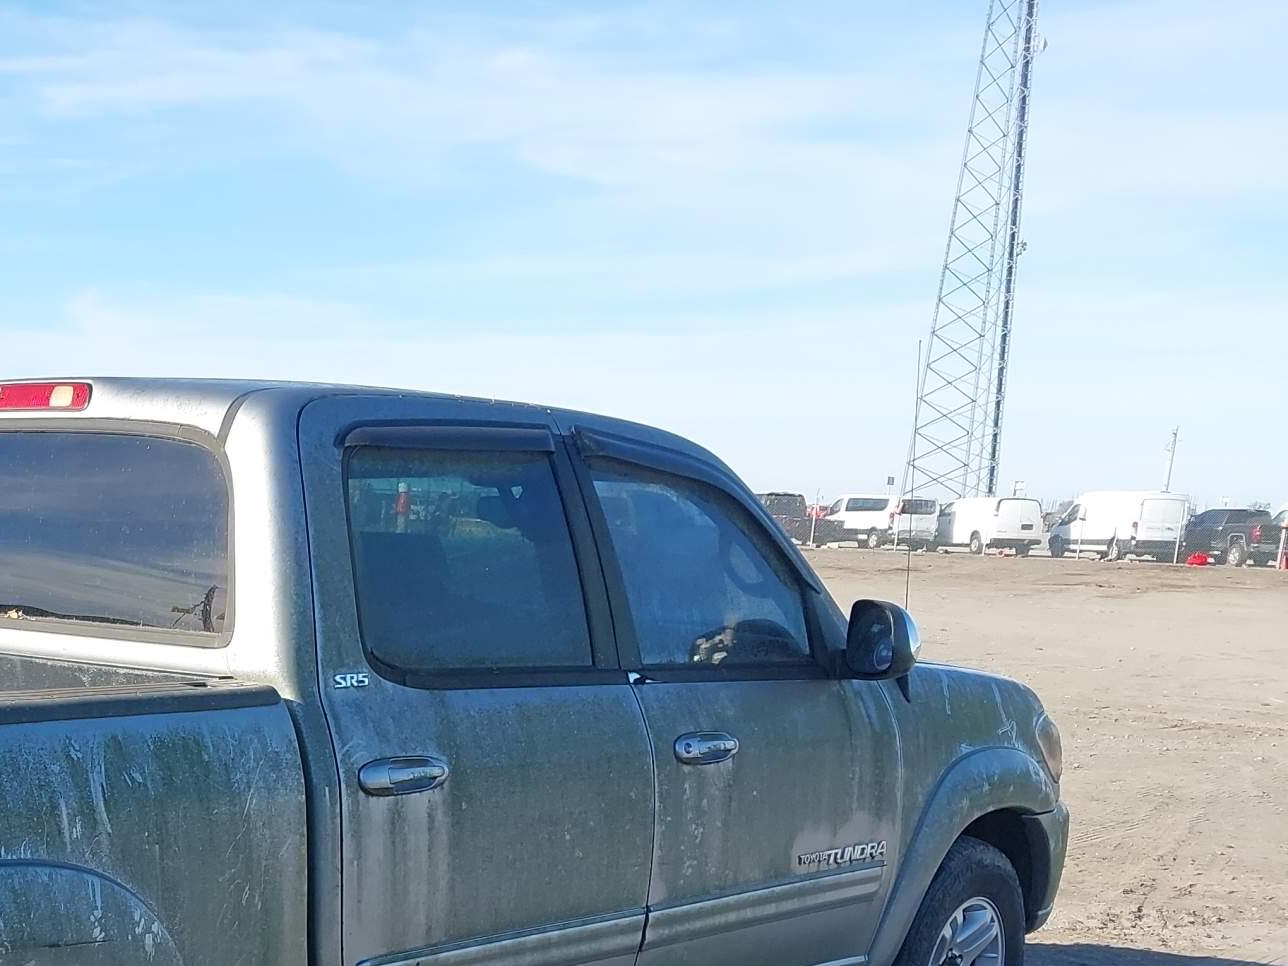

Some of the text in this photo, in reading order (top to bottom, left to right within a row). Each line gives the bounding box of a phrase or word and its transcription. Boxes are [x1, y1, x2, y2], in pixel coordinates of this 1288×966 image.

[334, 673, 369, 689] SR5
[798, 840, 887, 866] TOYOTA TUNDRA
